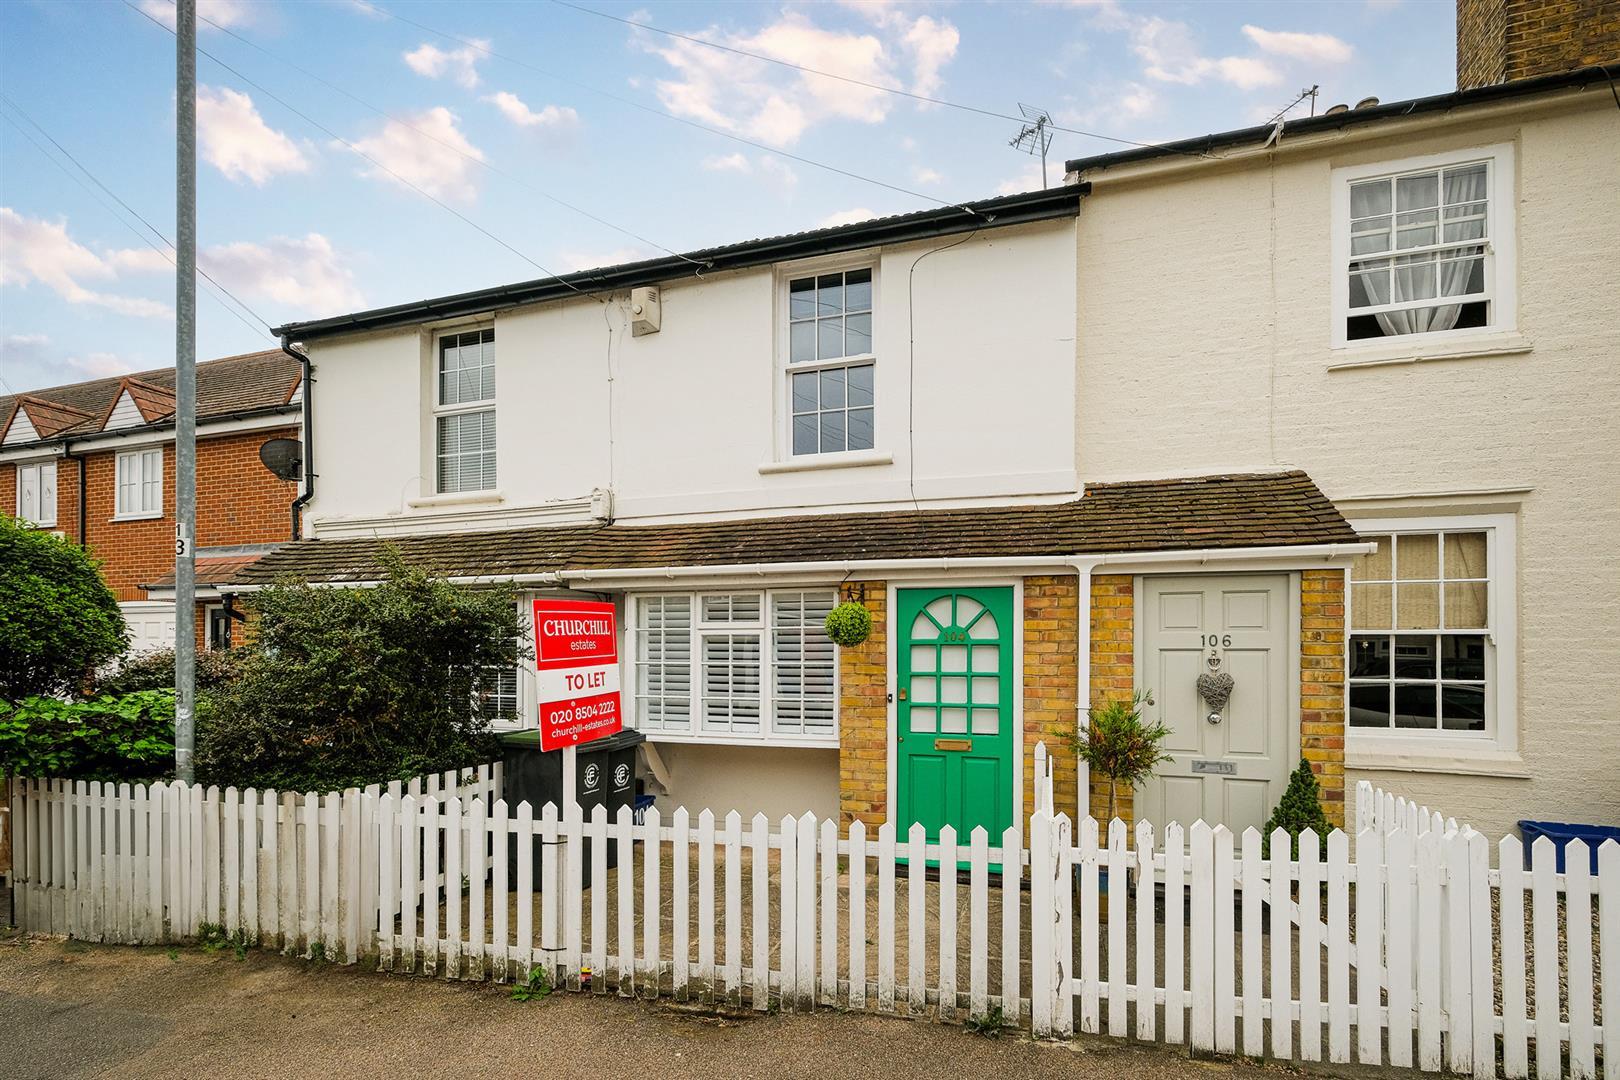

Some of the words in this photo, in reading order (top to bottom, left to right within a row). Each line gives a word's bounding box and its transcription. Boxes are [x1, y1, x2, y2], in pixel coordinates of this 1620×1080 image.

[543, 619, 611, 637] CHURCHILL
[570, 640, 597, 651] estates
[1201, 634, 1232, 647] 106
[565, 674, 584, 691] TO
[588, 671, 606, 688] LET
[551, 709, 573, 725] 020
[576, 705, 598, 721] 8504
[599, 701, 615, 714] 2222
[551, 716, 616, 738] churchill-estates.co.uk
